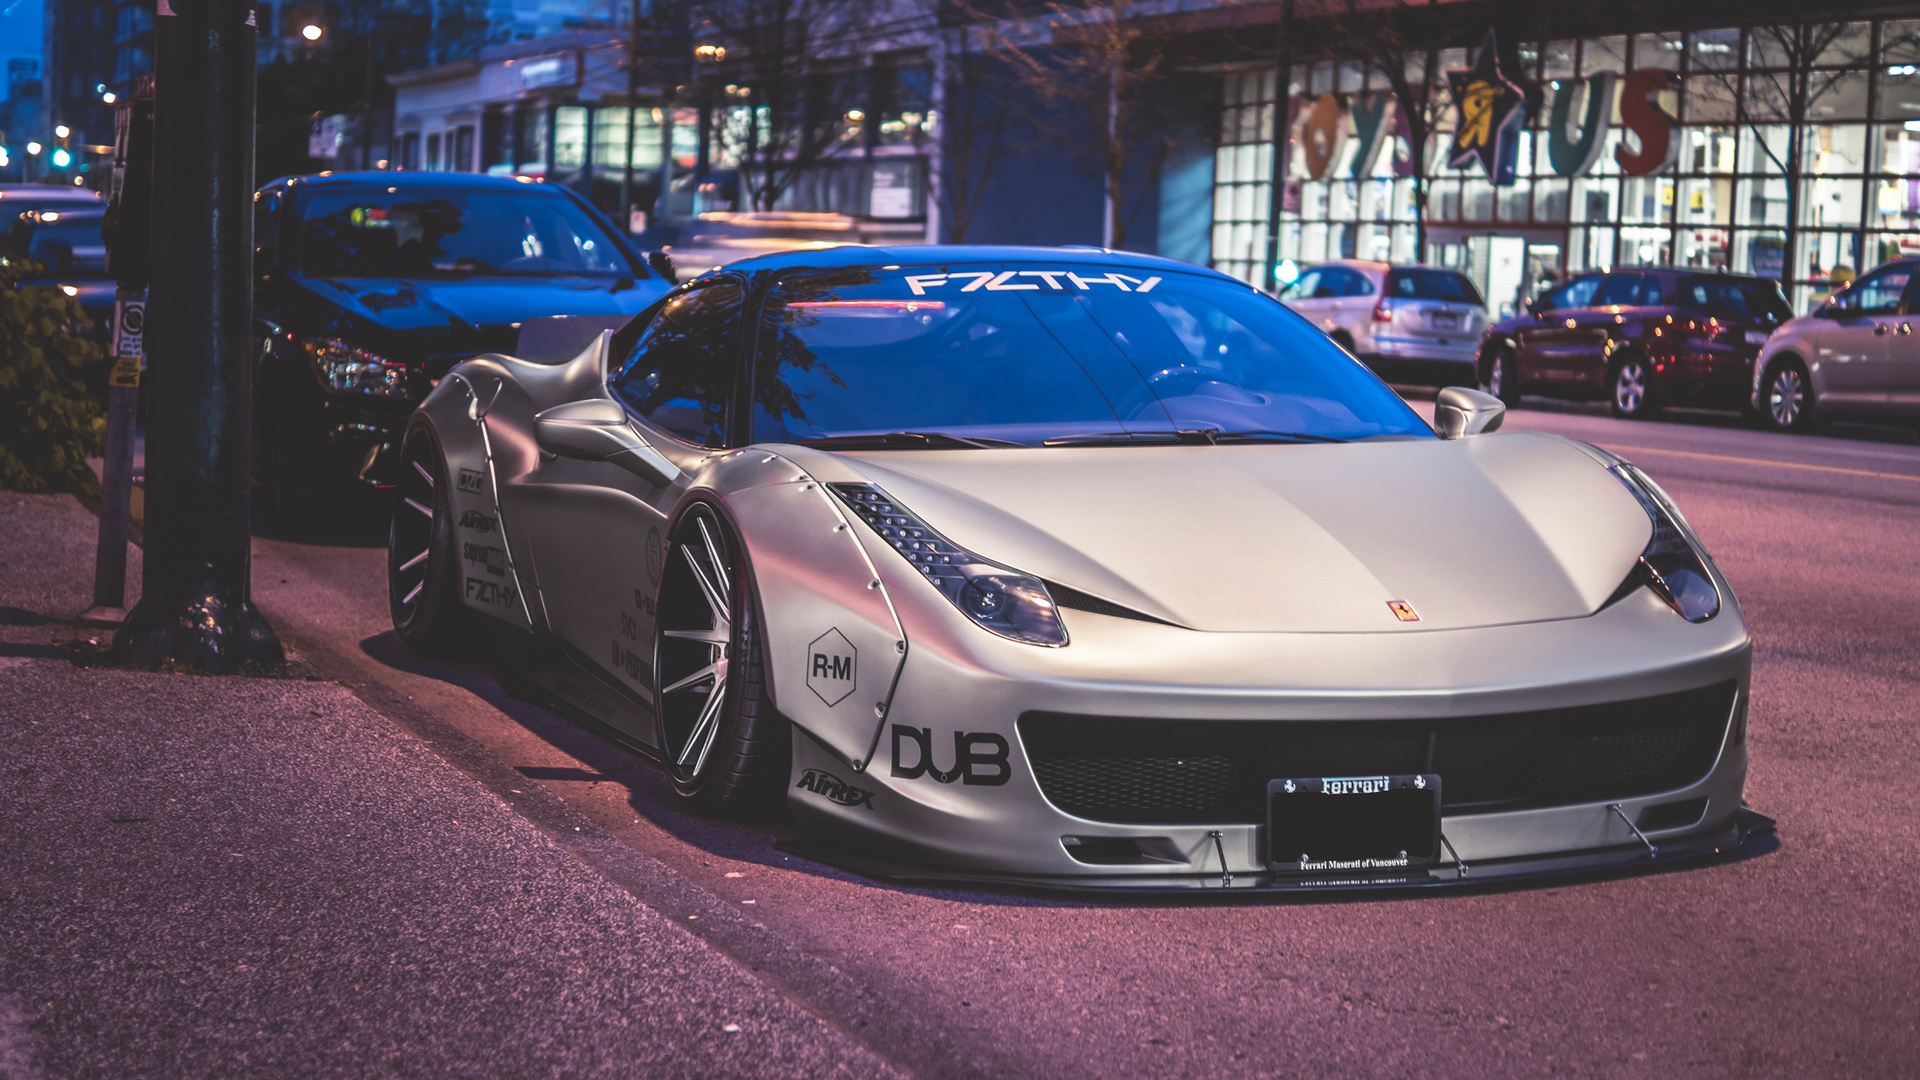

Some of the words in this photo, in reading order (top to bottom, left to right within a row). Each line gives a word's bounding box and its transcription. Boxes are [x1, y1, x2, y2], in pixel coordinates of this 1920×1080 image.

[1550, 67, 1670, 176] US
[812, 653, 852, 681] R-M
[890, 723, 1012, 786] DUB
[1320, 775, 1390, 795] Ferrari
[1300, 861, 1327, 871] Ferrari
[1328, 859, 1361, 870] Maserati
[1361, 858, 1370, 868] of
[1370, 857, 1408, 868] Vancouver
